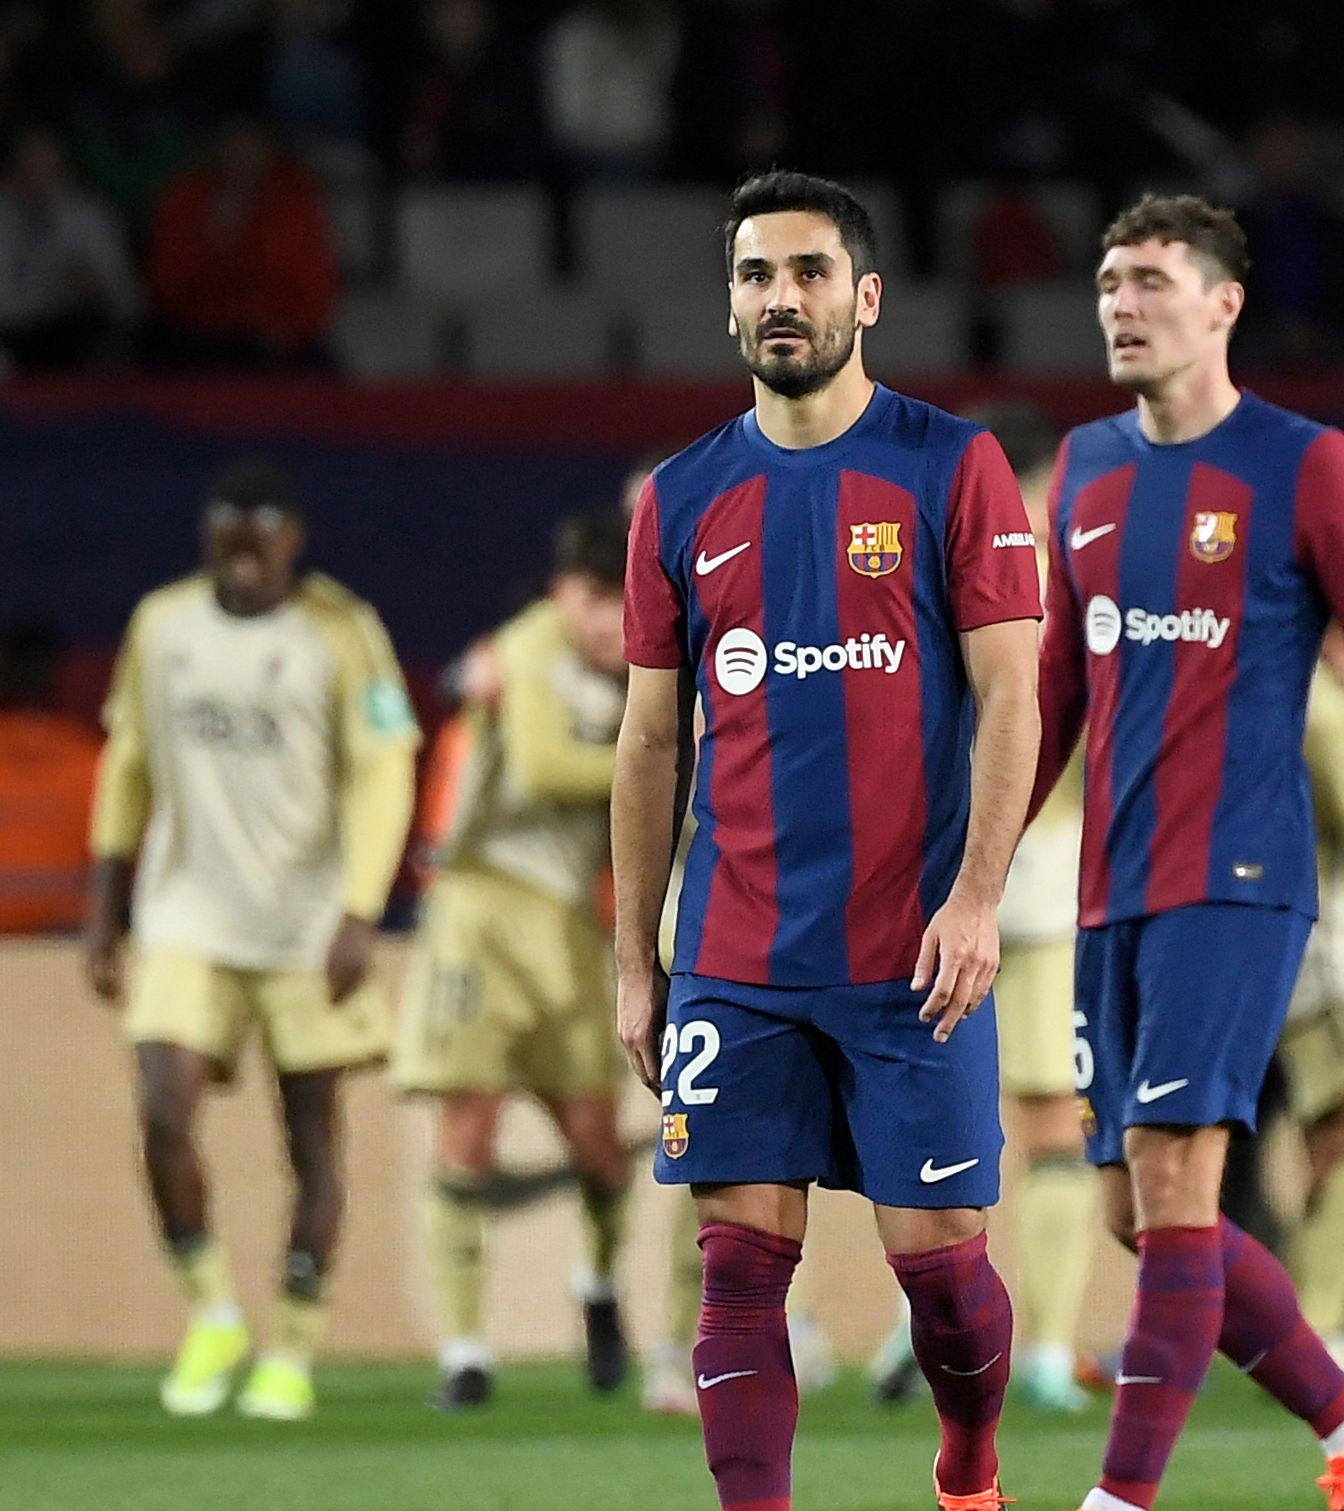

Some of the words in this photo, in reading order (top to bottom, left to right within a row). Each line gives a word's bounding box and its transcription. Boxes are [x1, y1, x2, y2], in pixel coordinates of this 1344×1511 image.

[1125, 607, 1231, 649] Spotify
[774, 632, 906, 679] Spotify
[661, 1020, 720, 1107] 22
